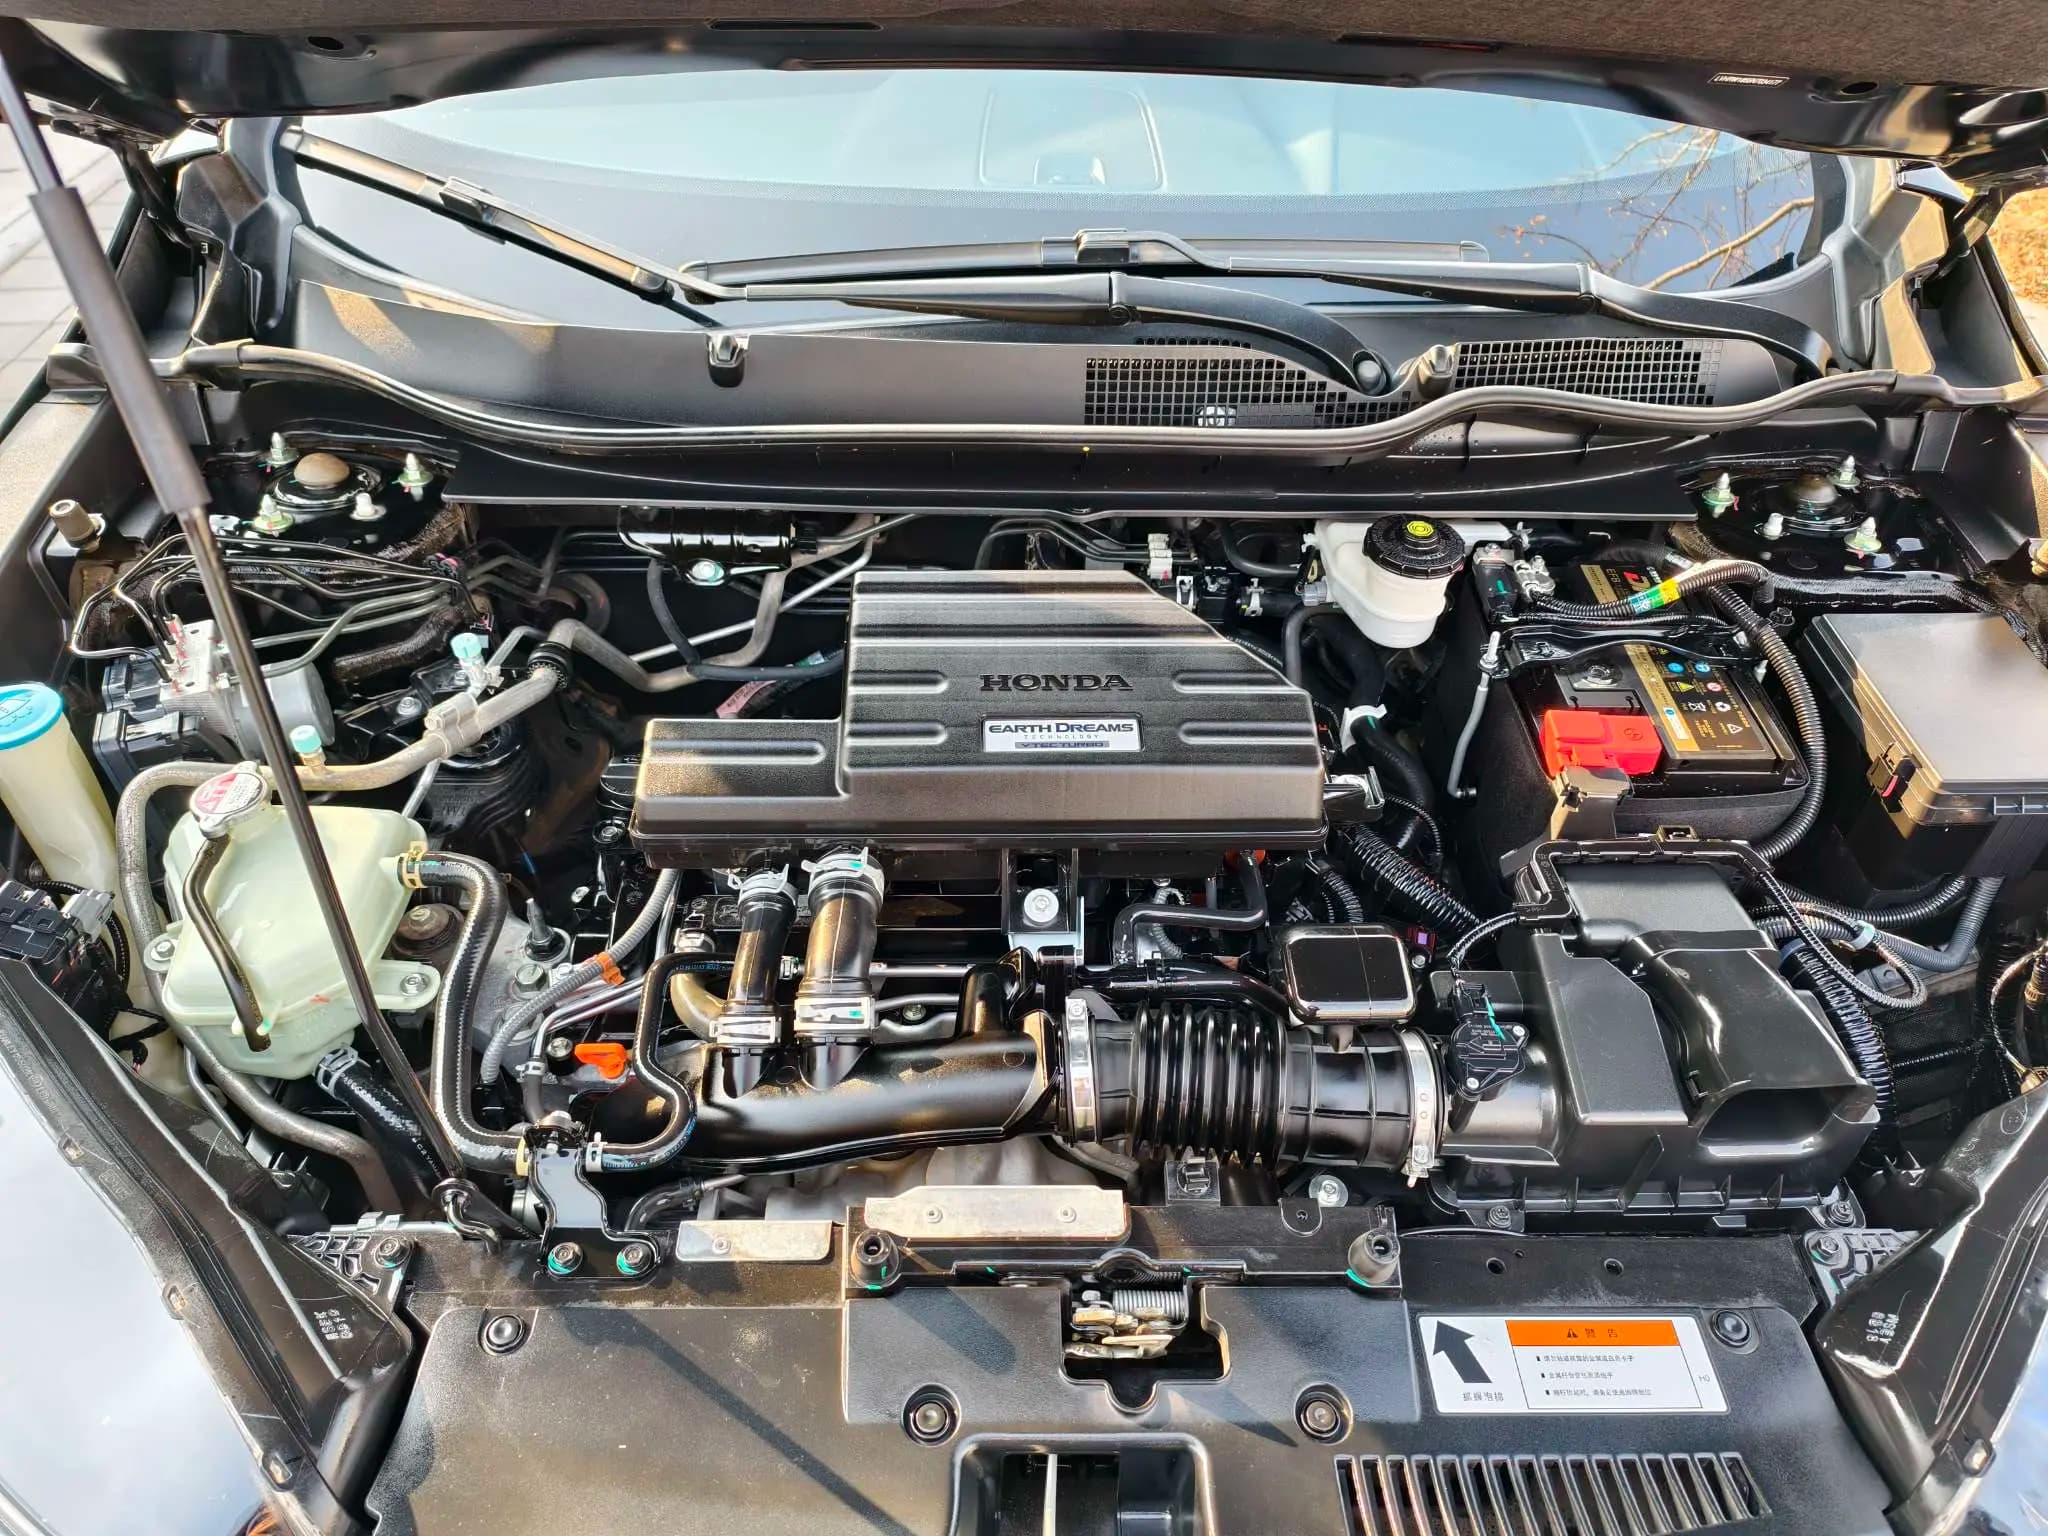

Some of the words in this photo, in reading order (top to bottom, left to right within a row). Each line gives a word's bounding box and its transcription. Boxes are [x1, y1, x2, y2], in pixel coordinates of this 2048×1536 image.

[980, 674, 1133, 691] HONDA
[989, 724, 1052, 733] EARTH
[1055, 722, 1134, 733] DREAMS
